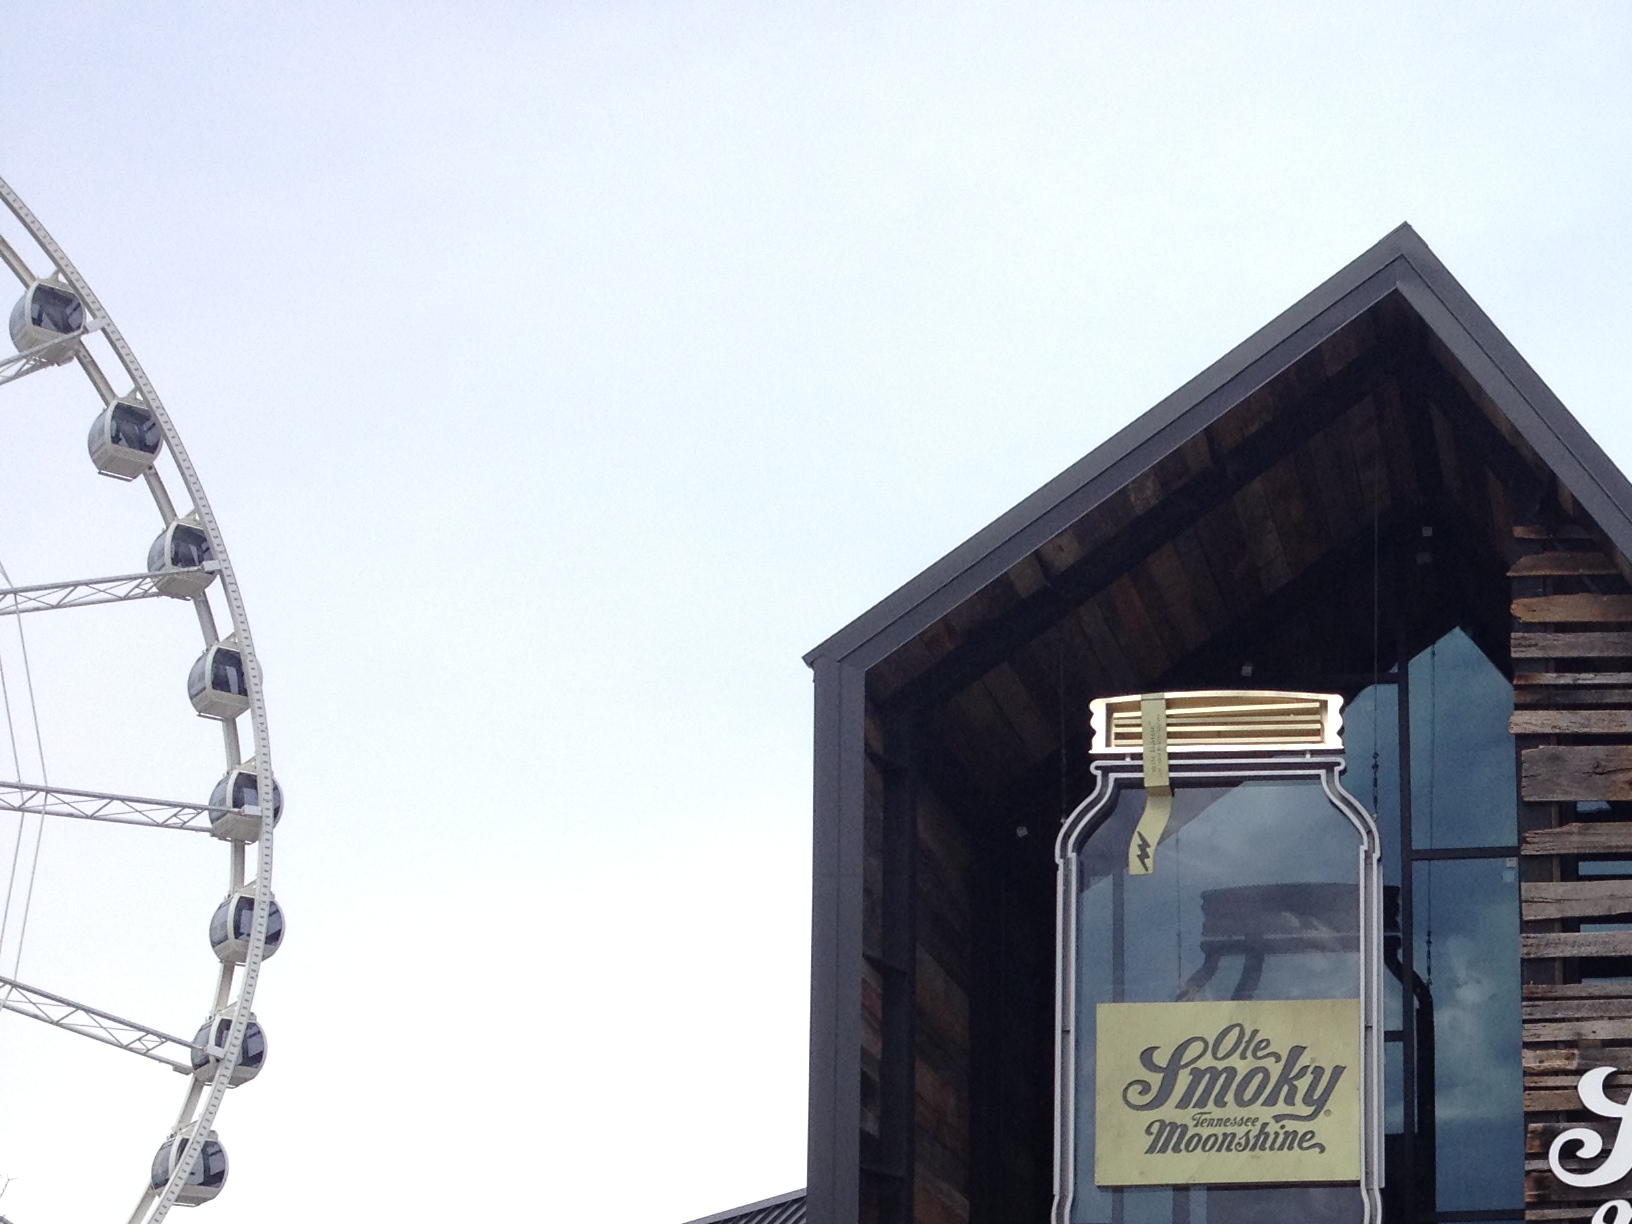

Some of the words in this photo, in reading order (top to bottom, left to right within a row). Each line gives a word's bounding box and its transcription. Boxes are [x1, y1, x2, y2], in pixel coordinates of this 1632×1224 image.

[1212, 1023, 1281, 1063] Ole
[1122, 1036, 1346, 1124] Smoky
[1145, 1118, 1325, 1155] Moonshine
[1192, 1112, 1259, 1128] Tennessee
